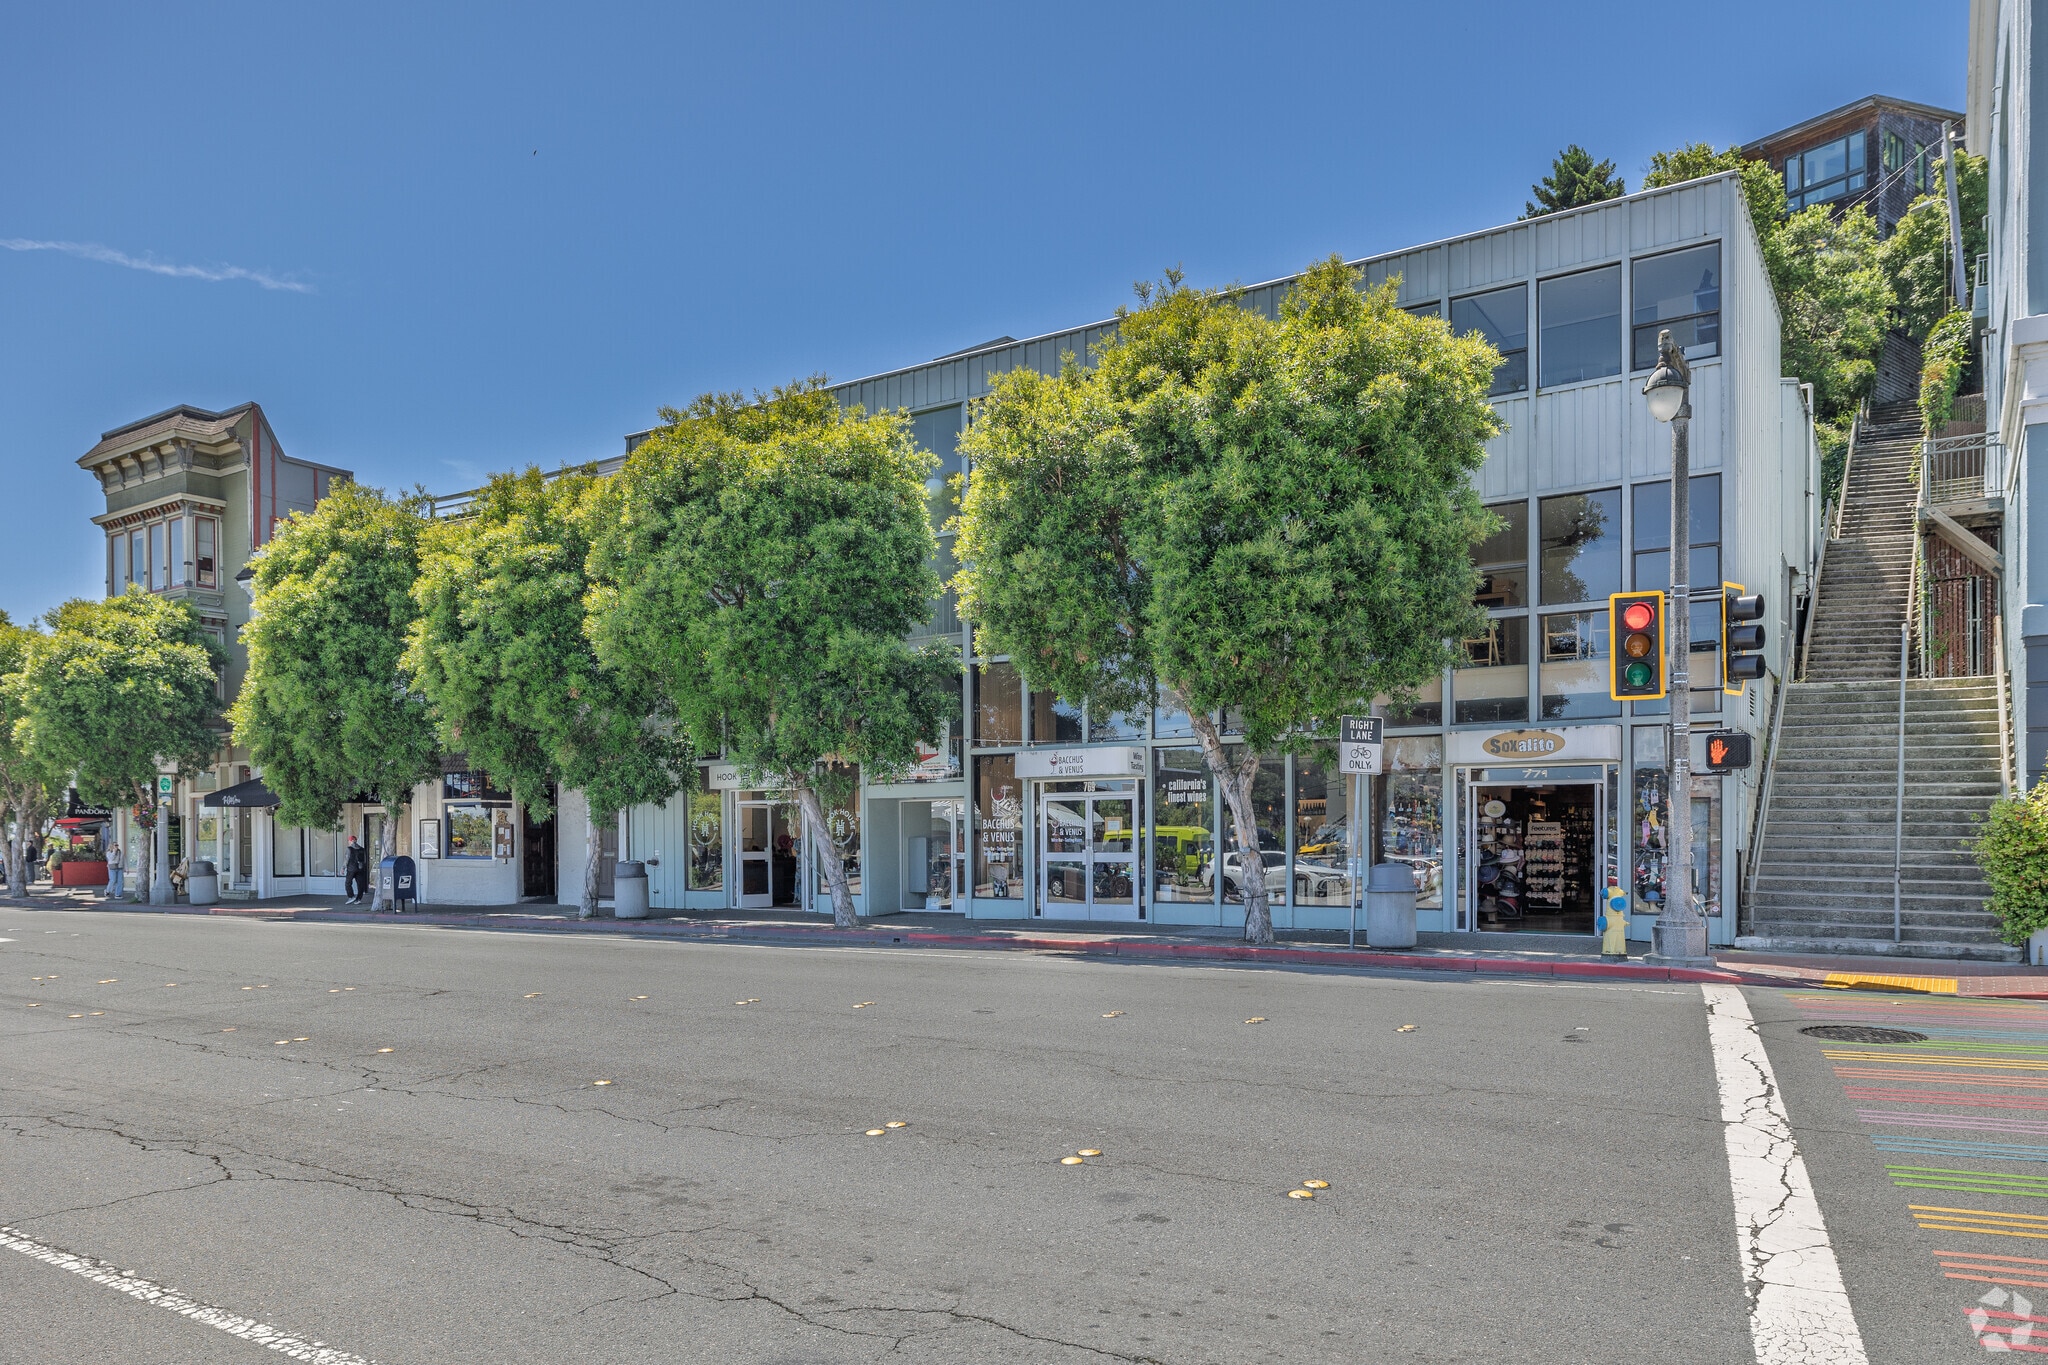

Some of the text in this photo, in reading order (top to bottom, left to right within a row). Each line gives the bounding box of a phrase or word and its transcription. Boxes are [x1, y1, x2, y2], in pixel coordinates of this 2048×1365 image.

[1350, 720, 1374, 730] RIGHT
[1350, 730, 1373, 740] LANE
[1490, 738, 1555, 753] Soxalito
[1058, 755, 1084, 764] BACCHUS
[1133, 752, 1142, 761] Wine
[1058, 765, 1084, 774] & VENUS
[1131, 761, 1144, 772] Tasting
[1349, 760, 1371, 769] ONLY
[716, 773, 738, 781] HOOK
[1083, 781, 1096, 792] 769
[1168, 779, 1207, 790] california's
[1168, 791, 1207, 803] finest wines
[839, 808, 856, 831] HOUSE
[982, 819, 1015, 829] BACCHUS
[983, 832, 1015, 842] & VENUS
